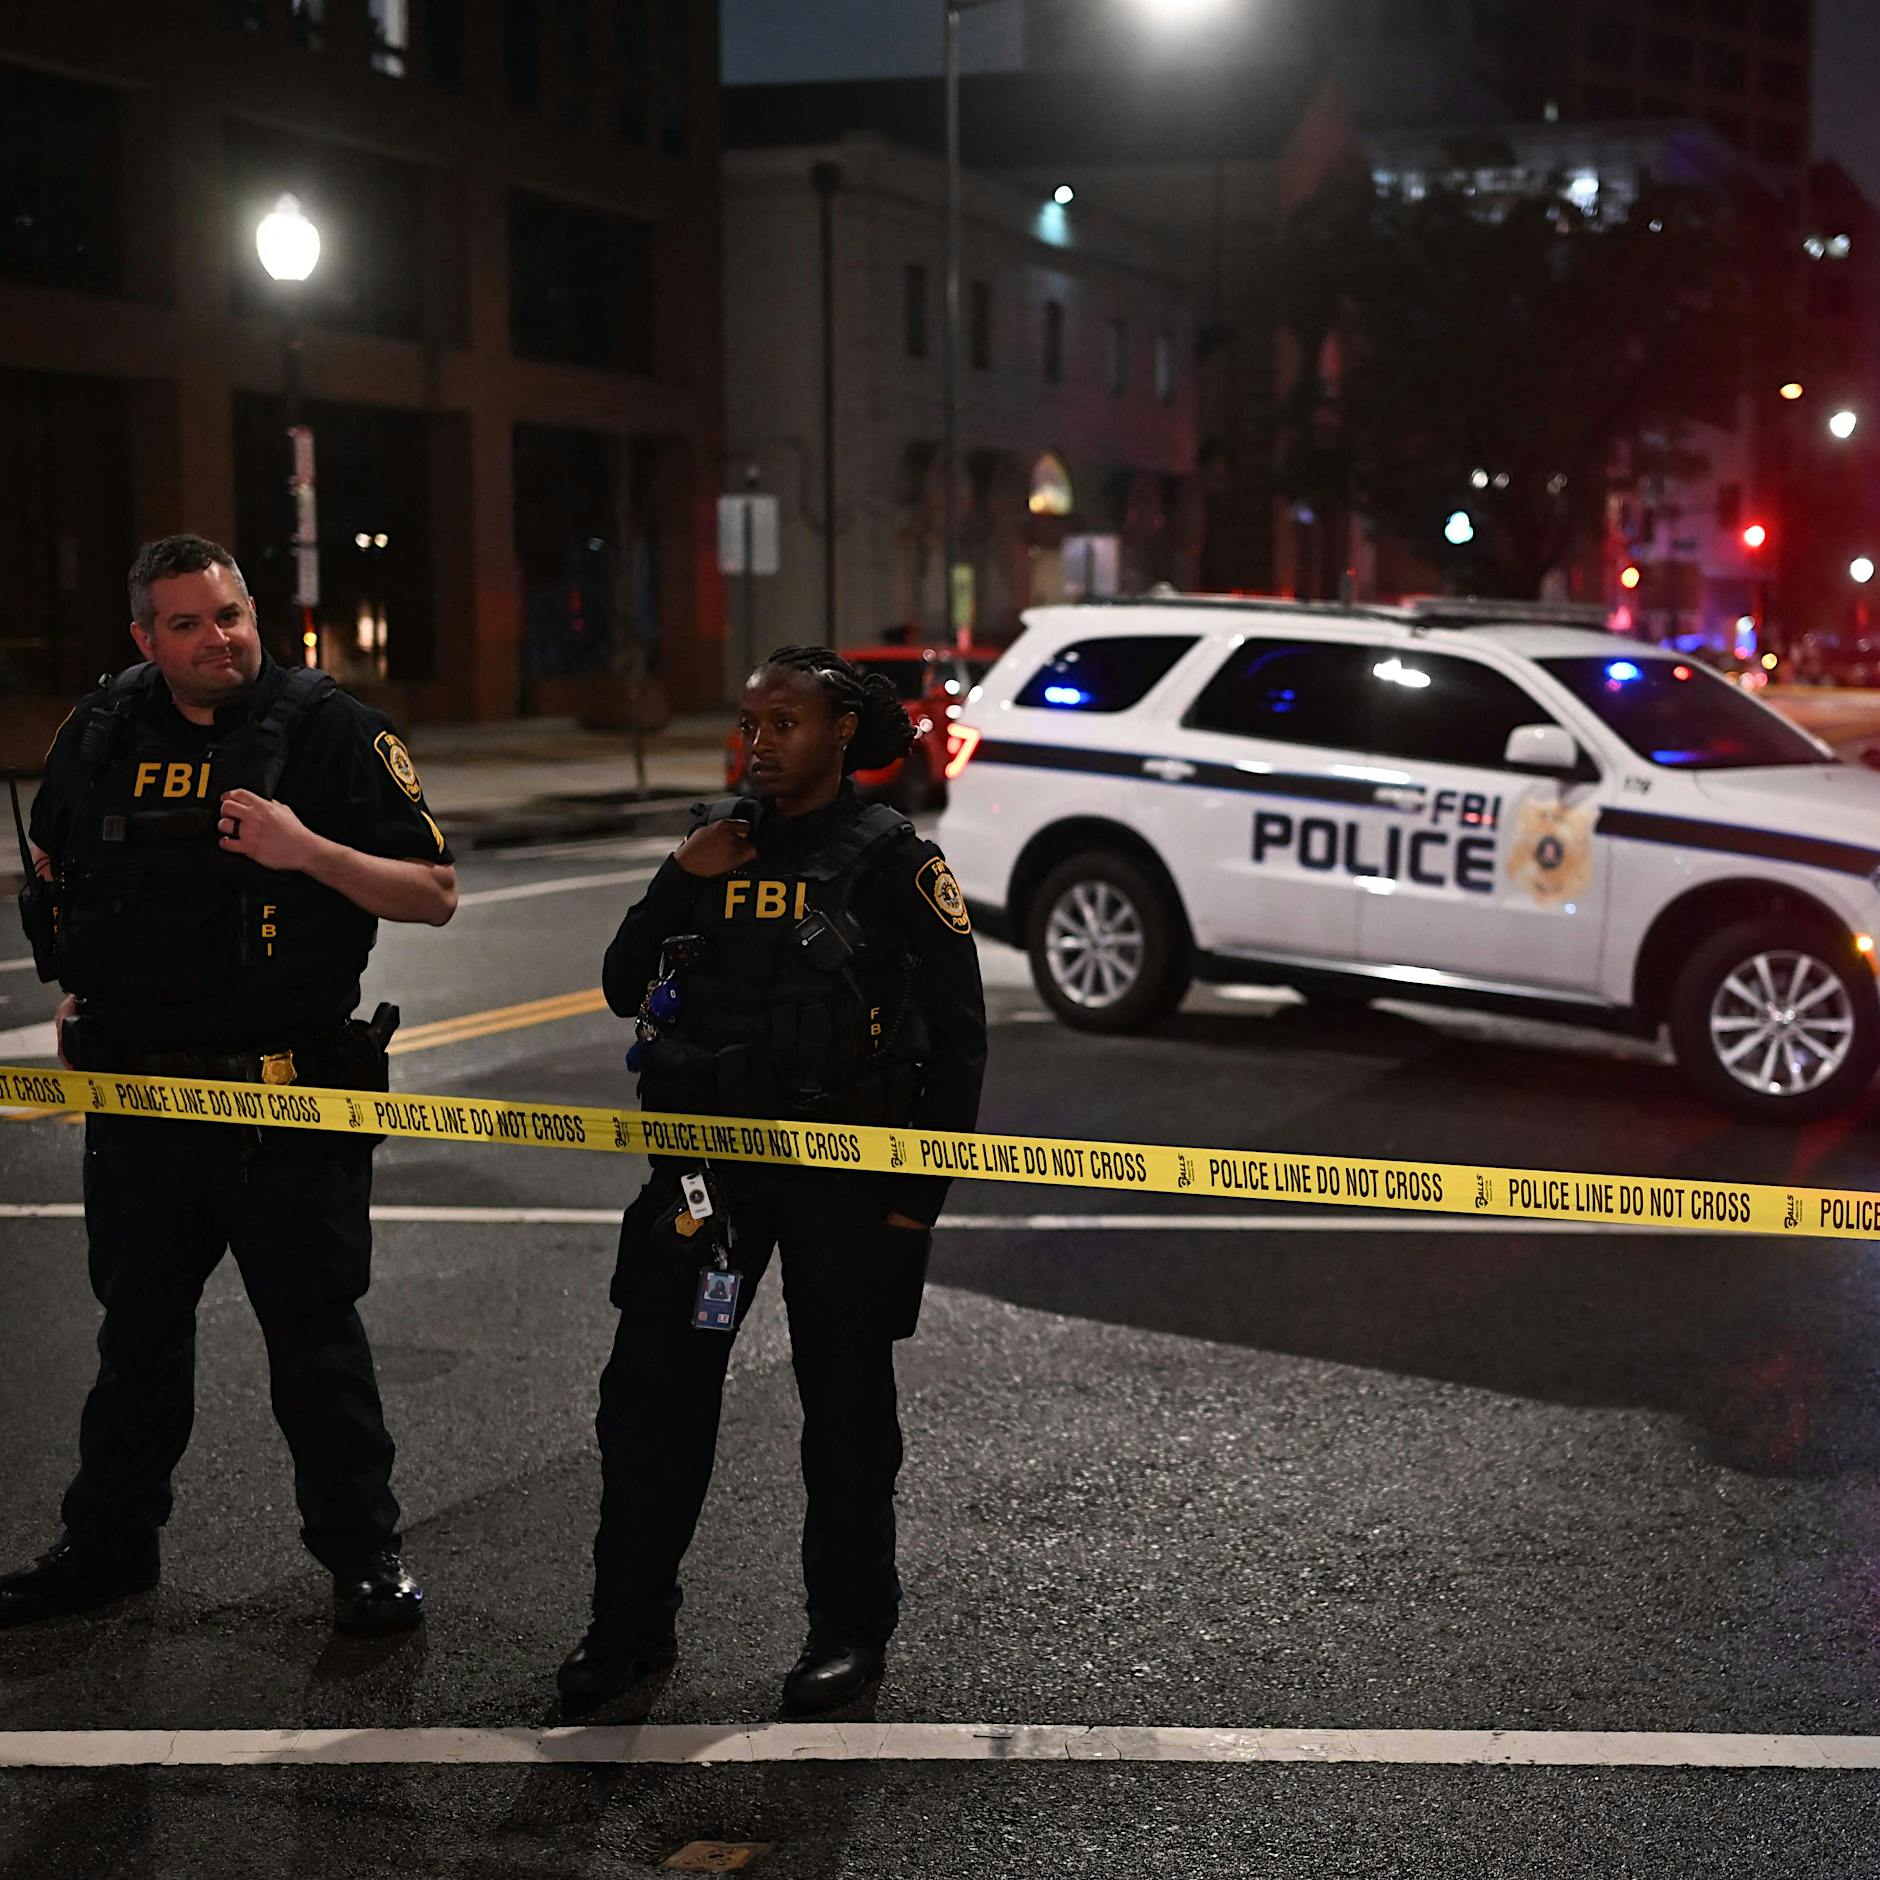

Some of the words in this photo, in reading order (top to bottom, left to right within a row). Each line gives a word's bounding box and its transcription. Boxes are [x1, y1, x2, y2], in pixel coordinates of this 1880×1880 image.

[133, 762, 211, 799] FBI
[1431, 790, 1503, 828] FBI
[1252, 810, 1496, 892] POLICE
[724, 879, 807, 920] FBI
[261, 904, 278, 957] FBI
[870, 1006, 882, 1049] FBI
[13, 1076, 66, 1104] CROSS
[116, 1083, 172, 1112] POLICE
[173, 1088, 206, 1115] LINE
[209, 1089, 233, 1119] DO
[237, 1091, 266, 1119] NOT
[269, 1095, 322, 1123] CROSS
[374, 1102, 430, 1132] POLICE
[433, 1107, 467, 1136] LINE
[470, 1109, 495, 1137] DO
[496, 1111, 529, 1140] NOT
[531, 1113, 586, 1144] CROSS
[641, 1121, 700, 1151] POLICE
[701, 1125, 740, 1154] LINE
[742, 1127, 765, 1156] DO
[767, 1129, 800, 1159] NOT
[805, 1132, 861, 1163] CROSS
[920, 1139, 979, 1170] POLICE
[983, 1144, 1020, 1173] LINE
[1023, 1147, 1048, 1175] DO
[1051, 1149, 1084, 1177] NOT
[1090, 1151, 1147, 1182] CROSS
[1209, 1159, 1269, 1190] POLICE
[1274, 1163, 1312, 1193] LINE
[1317, 1166, 1340, 1195] DO
[1345, 1168, 1379, 1197] NOT
[1385, 1170, 1443, 1202] CROSS
[1509, 1178, 1569, 1210] POLICE
[1575, 1183, 1614, 1213] LINE
[1620, 1186, 1643, 1216] DO
[1650, 1188, 1685, 1218] NOT
[1691, 1190, 1751, 1222] CROSS
